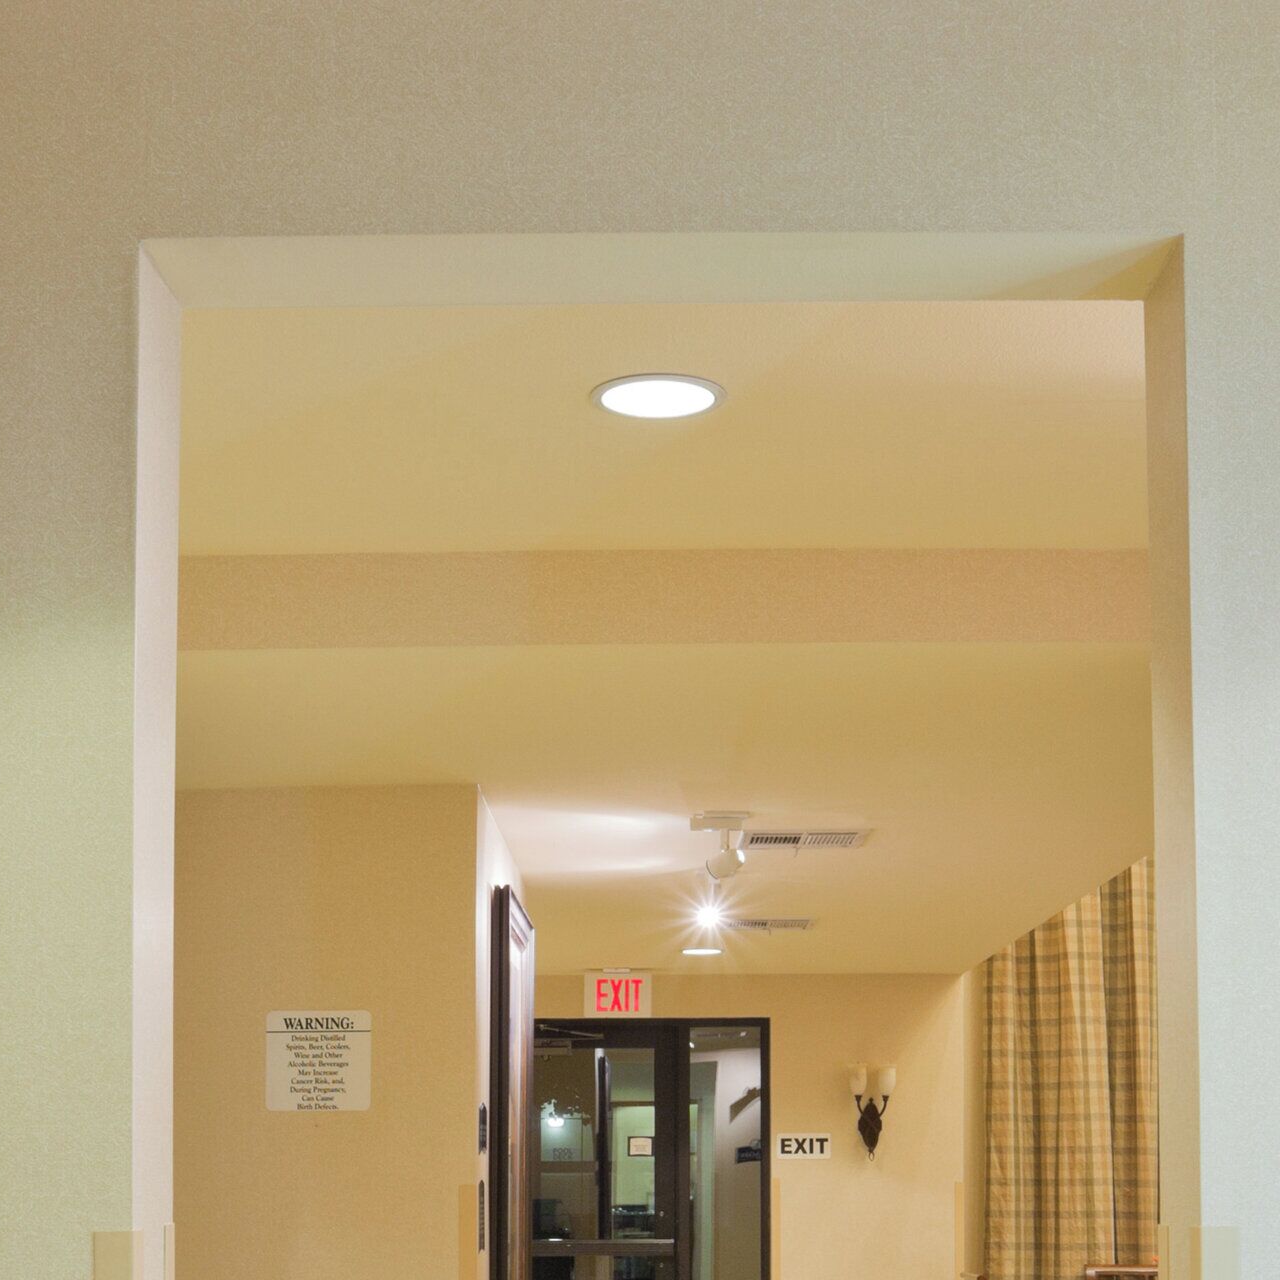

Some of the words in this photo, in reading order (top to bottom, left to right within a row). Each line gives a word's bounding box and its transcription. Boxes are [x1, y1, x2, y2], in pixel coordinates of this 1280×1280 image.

[595, 979, 644, 1012] EXIT
[283, 1017, 354, 1030] WARNING:
[291, 1034, 319, 1043] Drinking
[318, 1061, 349, 1069] Beverages
[290, 1086, 312, 1095] During
[780, 1138, 829, 1155] EXIT
